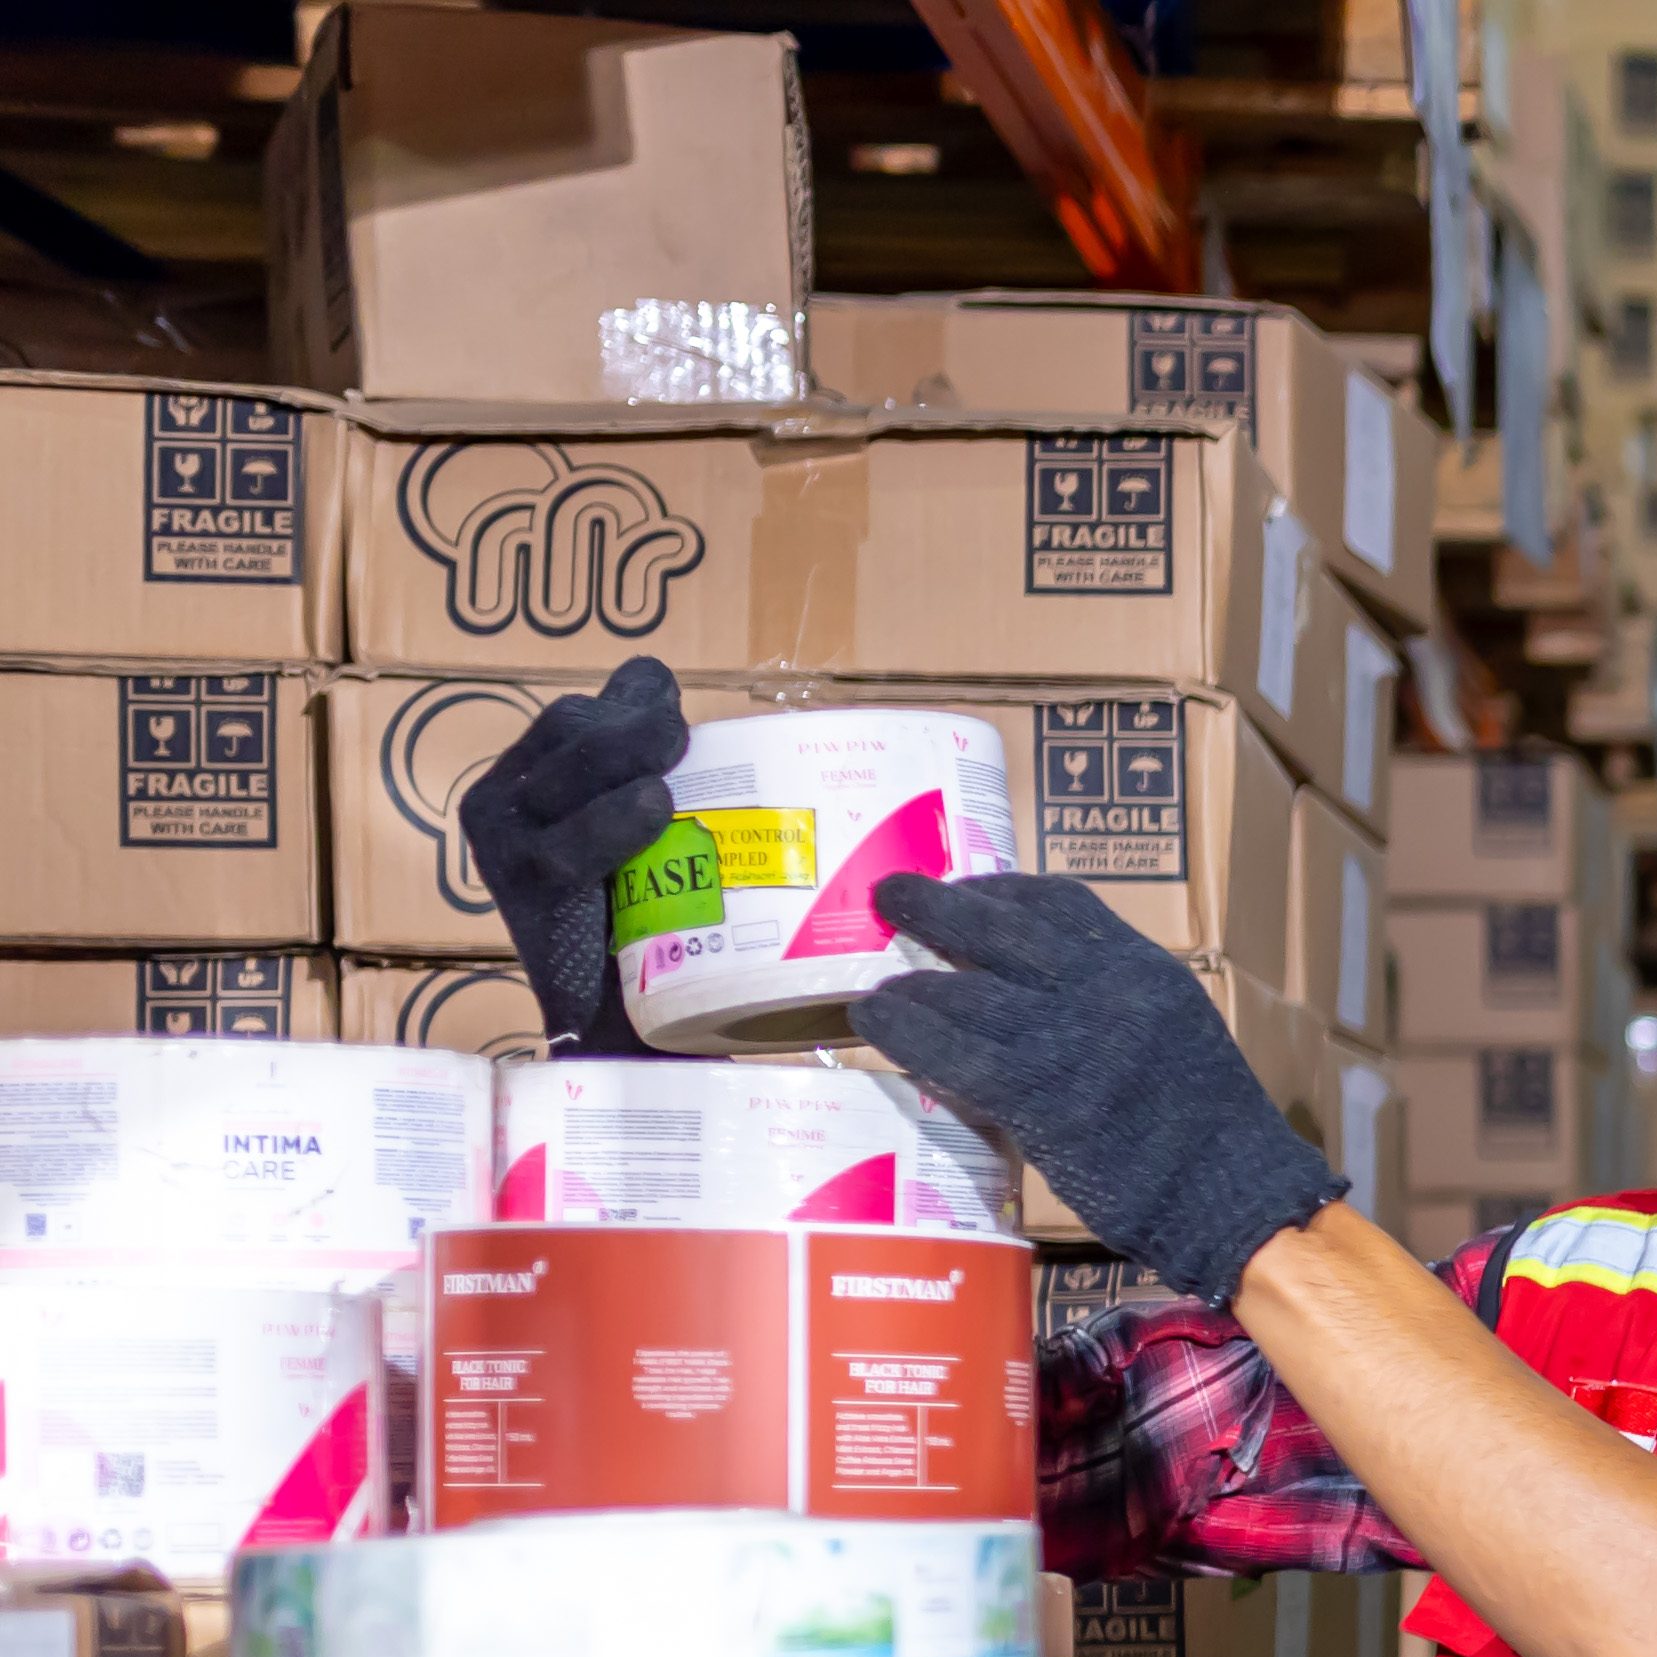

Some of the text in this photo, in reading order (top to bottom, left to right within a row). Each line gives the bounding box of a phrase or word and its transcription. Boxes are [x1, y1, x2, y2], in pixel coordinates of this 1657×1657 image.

[152, 507, 294, 534] FRAGILE
[1032, 523, 1166, 550] FRAGILE
[127, 771, 269, 799] FRAGILE
[1044, 807, 1180, 833] FRAGILE
[731, 827, 806, 845] CONTROL
[222, 1133, 323, 1157] INTIMA
[443, 1271, 536, 1295] FIRSTMAN
[830, 1274, 955, 1301] FIRSTMAN
[849, 1362, 901, 1378] BLACK
[864, 1379, 898, 1394] FOR
[1075, 1614, 1177, 1642] AGILE
